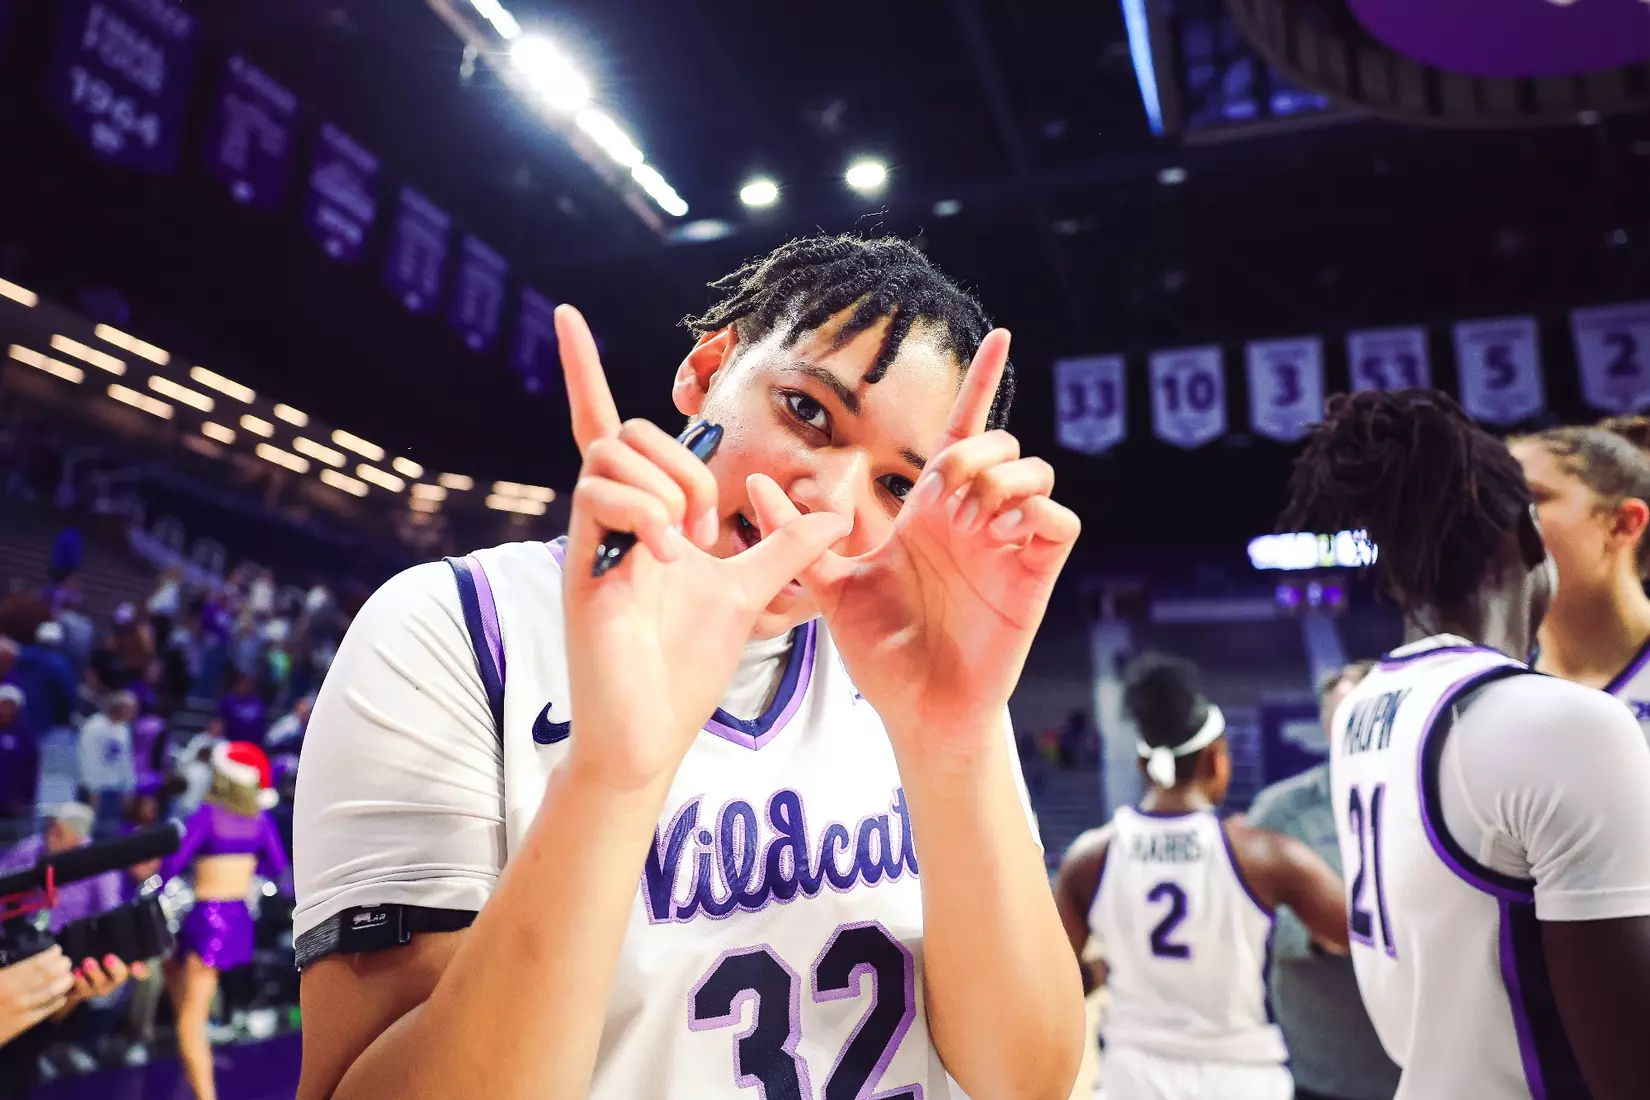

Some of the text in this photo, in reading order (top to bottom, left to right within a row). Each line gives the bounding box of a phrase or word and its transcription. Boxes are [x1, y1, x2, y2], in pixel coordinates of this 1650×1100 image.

[1484, 344, 1517, 391] 5
[1605, 332, 1642, 377] 2
[1060, 379, 1116, 422] 33
[1162, 371, 1216, 413] 10
[1270, 364, 1301, 407] 3
[641, 785, 920, 925] ildcat
[1349, 781, 1398, 960] 21
[1147, 881, 1191, 960] 2
[687, 919, 924, 1100] 32
